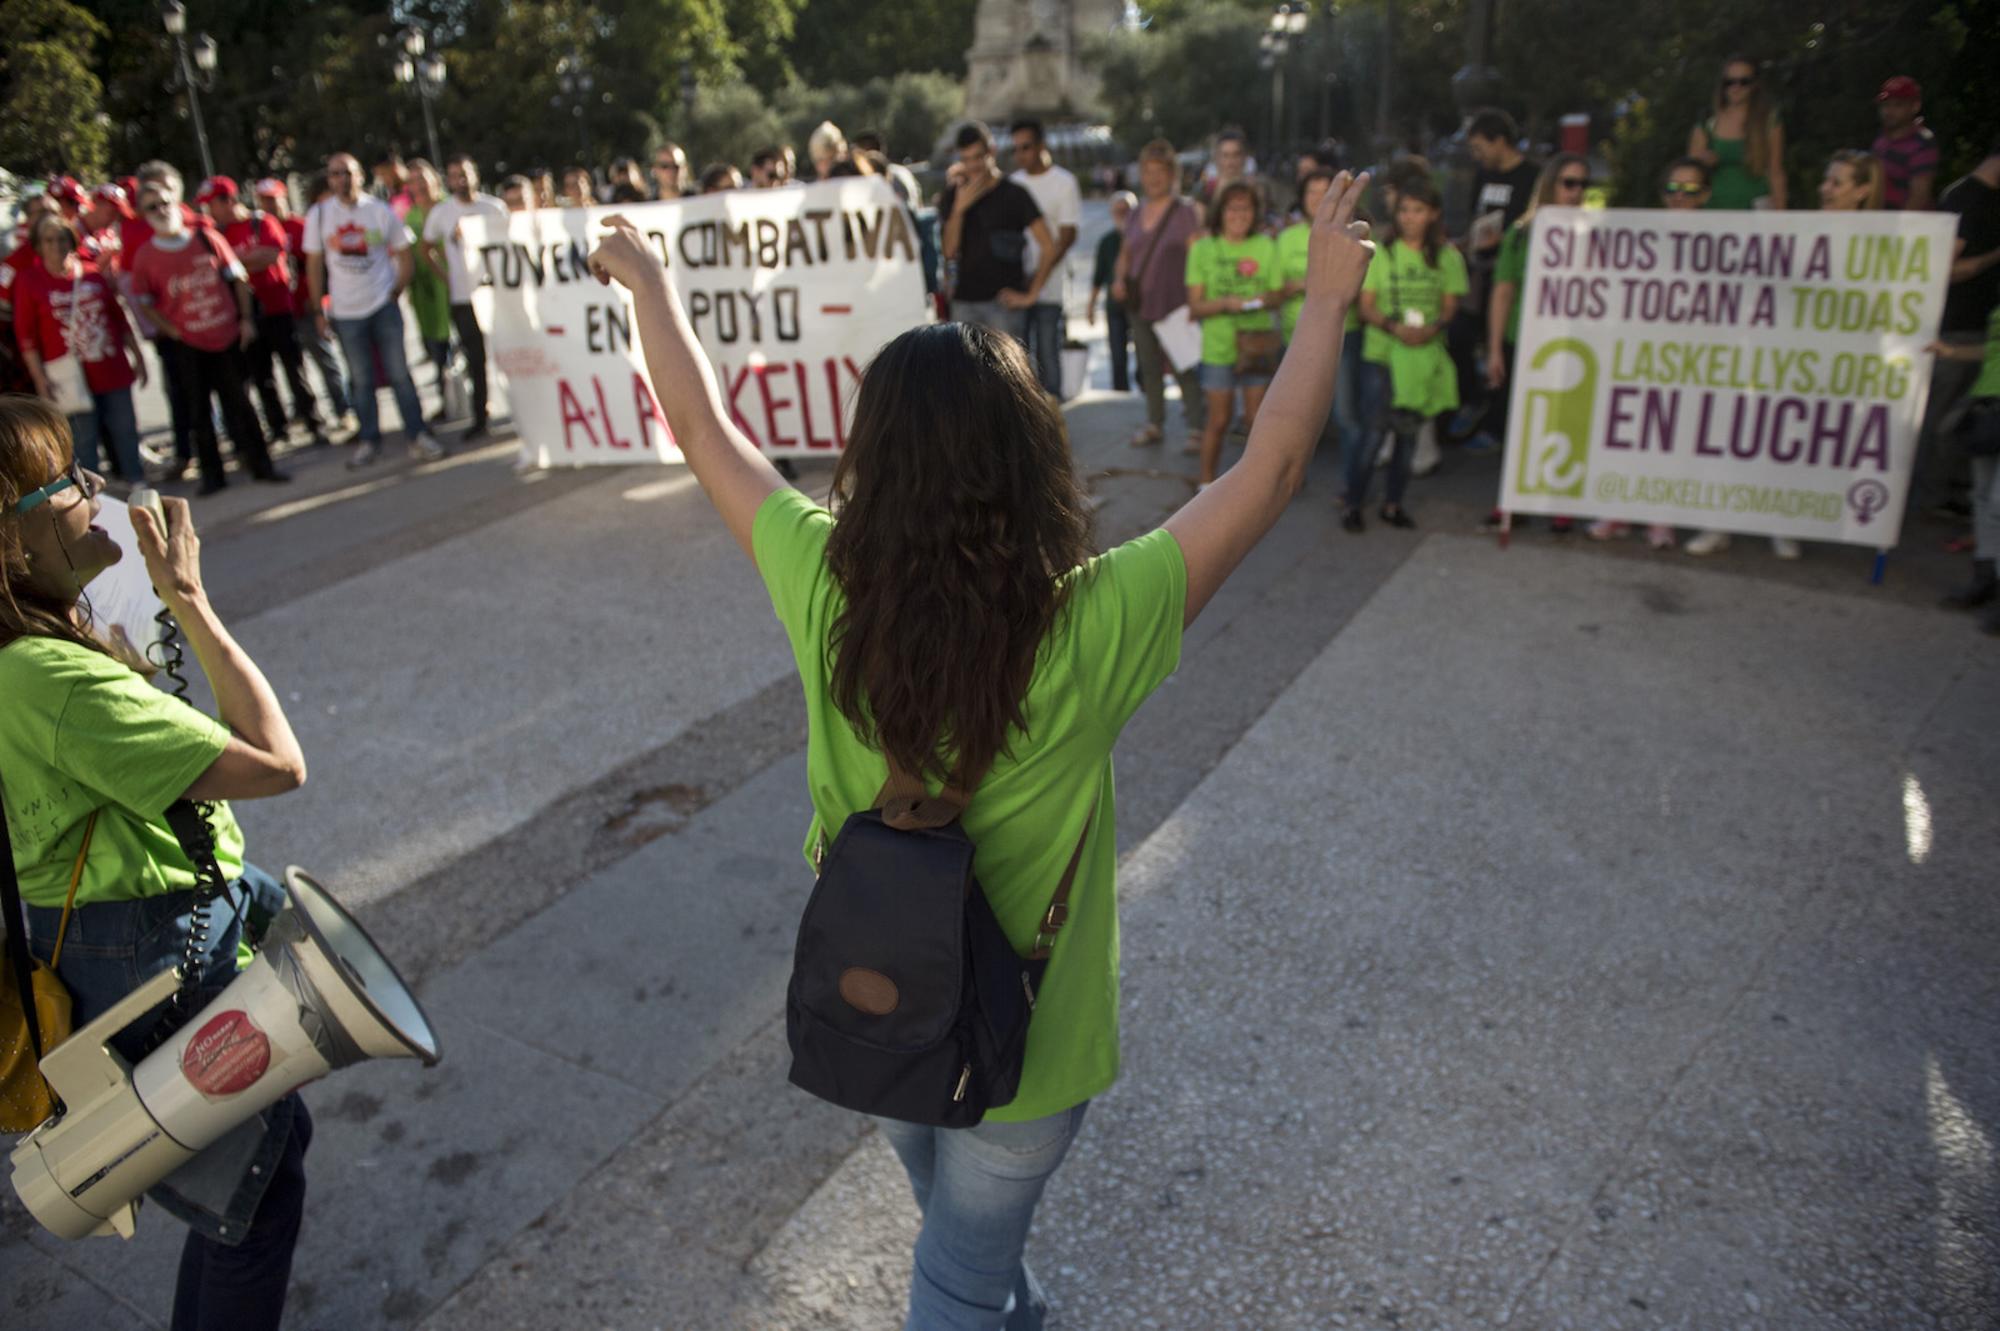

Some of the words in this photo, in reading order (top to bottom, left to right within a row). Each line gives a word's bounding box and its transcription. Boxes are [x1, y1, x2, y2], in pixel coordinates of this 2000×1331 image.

[679, 206, 915, 269] COMBATIVA
[1543, 226, 1575, 268] SI
[1586, 228, 1658, 271] NOS
[1667, 231, 1796, 277] TOCAN
[1803, 233, 1831, 281] A
[1844, 233, 1931, 282] UNA
[585, 304, 632, 354] EN
[690, 286, 802, 343] POYO
[1537, 276, 1609, 319] NOS
[1620, 278, 1744, 325] TOCAN
[1750, 284, 1776, 328] A
[1791, 286, 1924, 335] TODAS
[1610, 339, 1912, 400] LASKELLYS.ORG
[1604, 385, 1680, 454] EN
[1695, 391, 1889, 473] LUCHA
[1594, 470, 1843, 523] @LASKELLYSMADRID
